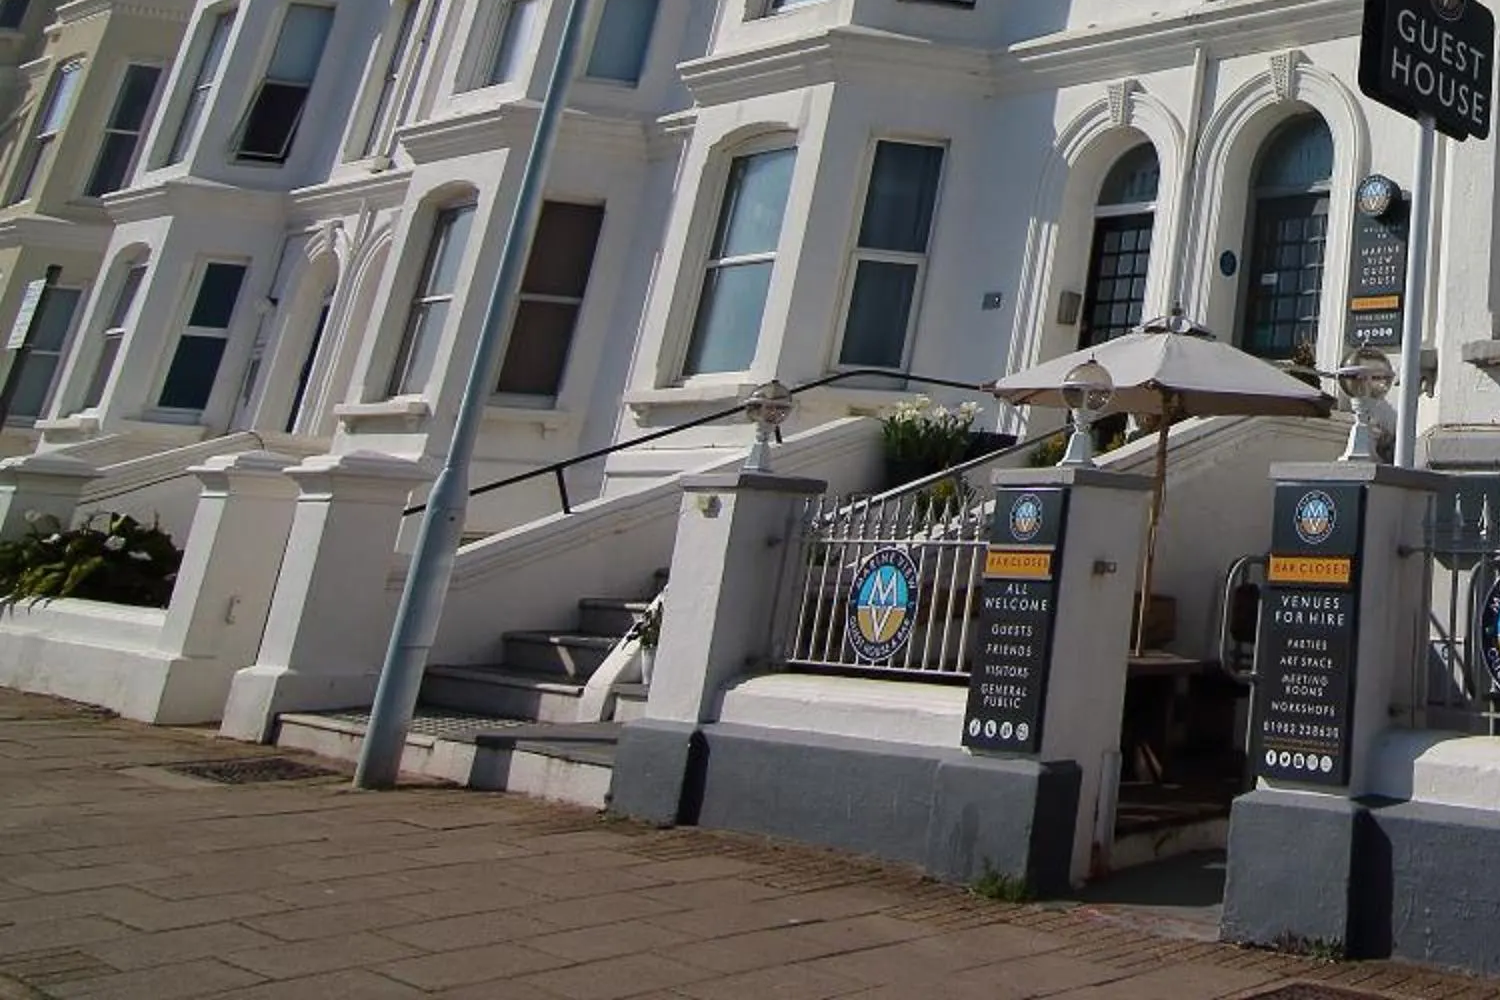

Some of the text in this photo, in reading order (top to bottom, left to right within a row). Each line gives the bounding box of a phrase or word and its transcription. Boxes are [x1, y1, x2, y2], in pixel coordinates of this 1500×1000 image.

[1397, 9, 1485, 80] GUEST
[1391, 47, 1485, 124] HOUSE
[1273, 562, 1348, 576] BAR CLOSED
[1005, 583, 1028, 595] ALL
[985, 597, 1048, 611] WELCOME
[1280, 594, 1341, 610] VENUES
[1275, 610, 1345, 627] FOR HIRE
[991, 623, 1033, 637] GUESTS
[985, 643, 1032, 657] FRIENDS
[1287, 638, 1327, 651] PARTIES
[1280, 655, 1333, 669] ART SPACE
[985, 664, 1030, 679] VISITORS
[1281, 673, 1328, 687] MEETING
[980, 683, 1028, 697] GENERAL
[1285, 685, 1323, 697] ROOMS
[983, 695, 1021, 709] PUBLIC
[1271, 700, 1335, 717] WORKSHOPS
